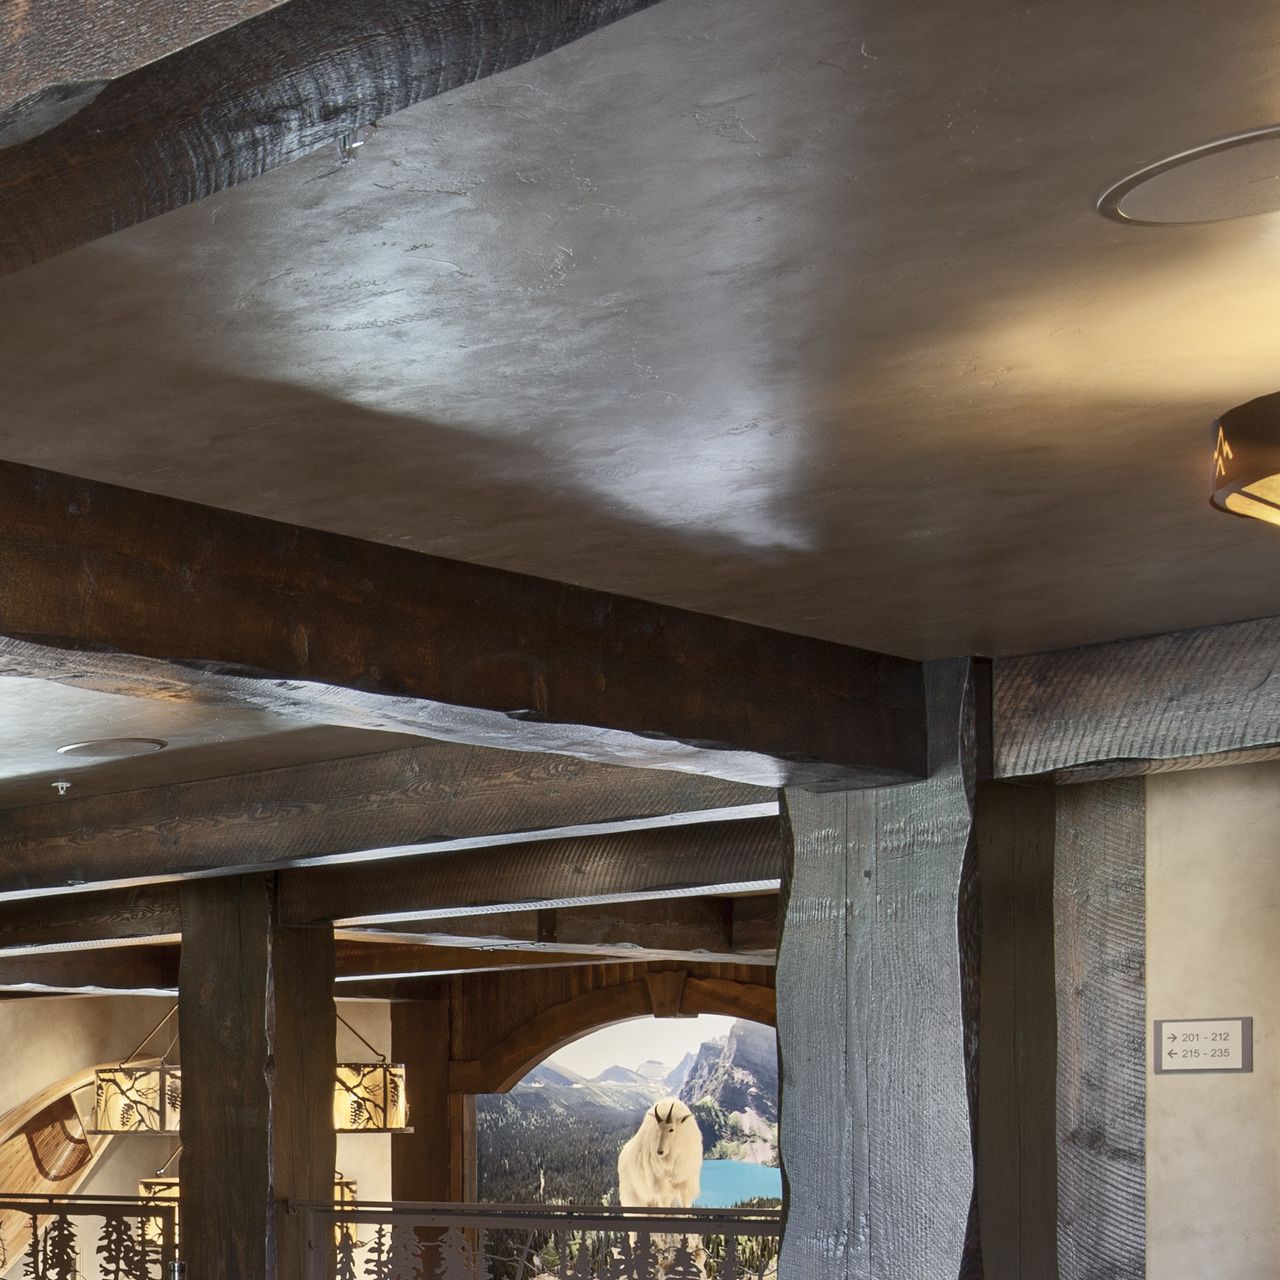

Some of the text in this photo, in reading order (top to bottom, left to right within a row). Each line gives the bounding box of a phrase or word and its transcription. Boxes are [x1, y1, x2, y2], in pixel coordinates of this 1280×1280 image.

[1182, 1033, 1199, 1042] 201
[1211, 1032, 1229, 1041] 212
[1182, 1049, 1200, 1058] 215
[1211, 1048, 1230, 1057] 235
